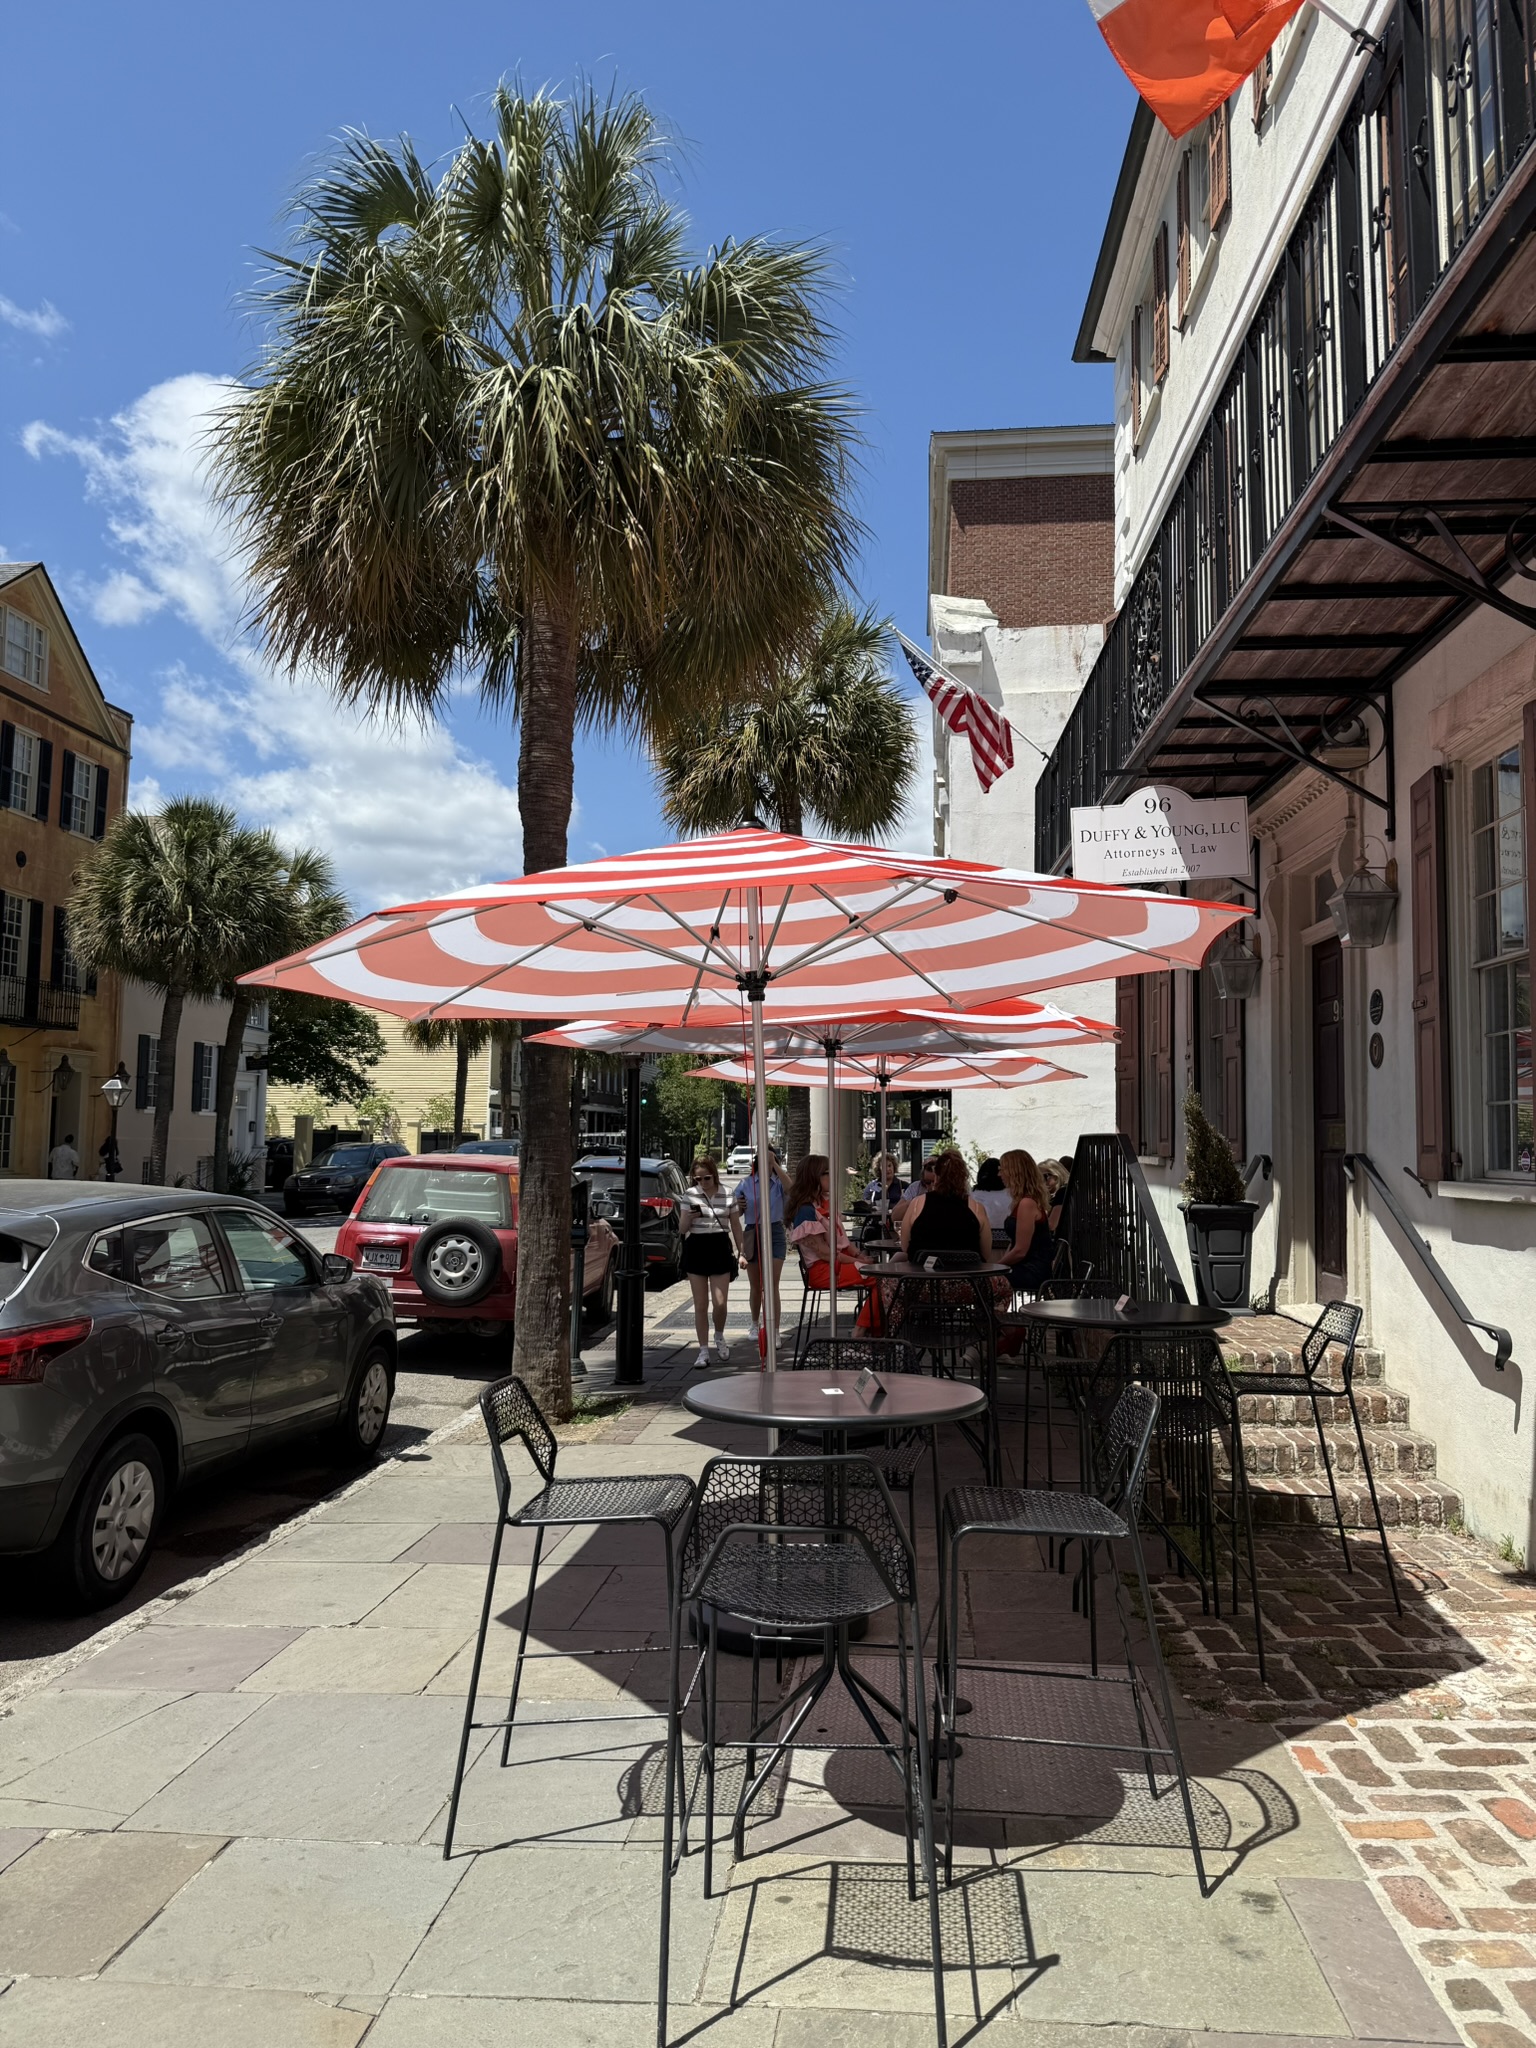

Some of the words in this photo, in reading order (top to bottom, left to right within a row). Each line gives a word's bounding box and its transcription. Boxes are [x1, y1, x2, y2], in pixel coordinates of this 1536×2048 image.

[1144, 797, 1171, 814] 96
[1080, 828, 1131, 843] DUFFY
[1134, 825, 1148, 840] &
[1151, 823, 1209, 839] YOUNG,
[1212, 821, 1241, 835] LLC
[1103, 847, 1165, 860] Attorneys
[1171, 846, 1183, 855] at
[1191, 843, 1218, 854] Law
[1122, 866, 1168, 878] Established
[1180, 864, 1201, 874] 2007
[385, 1253, 398, 1264] 901
